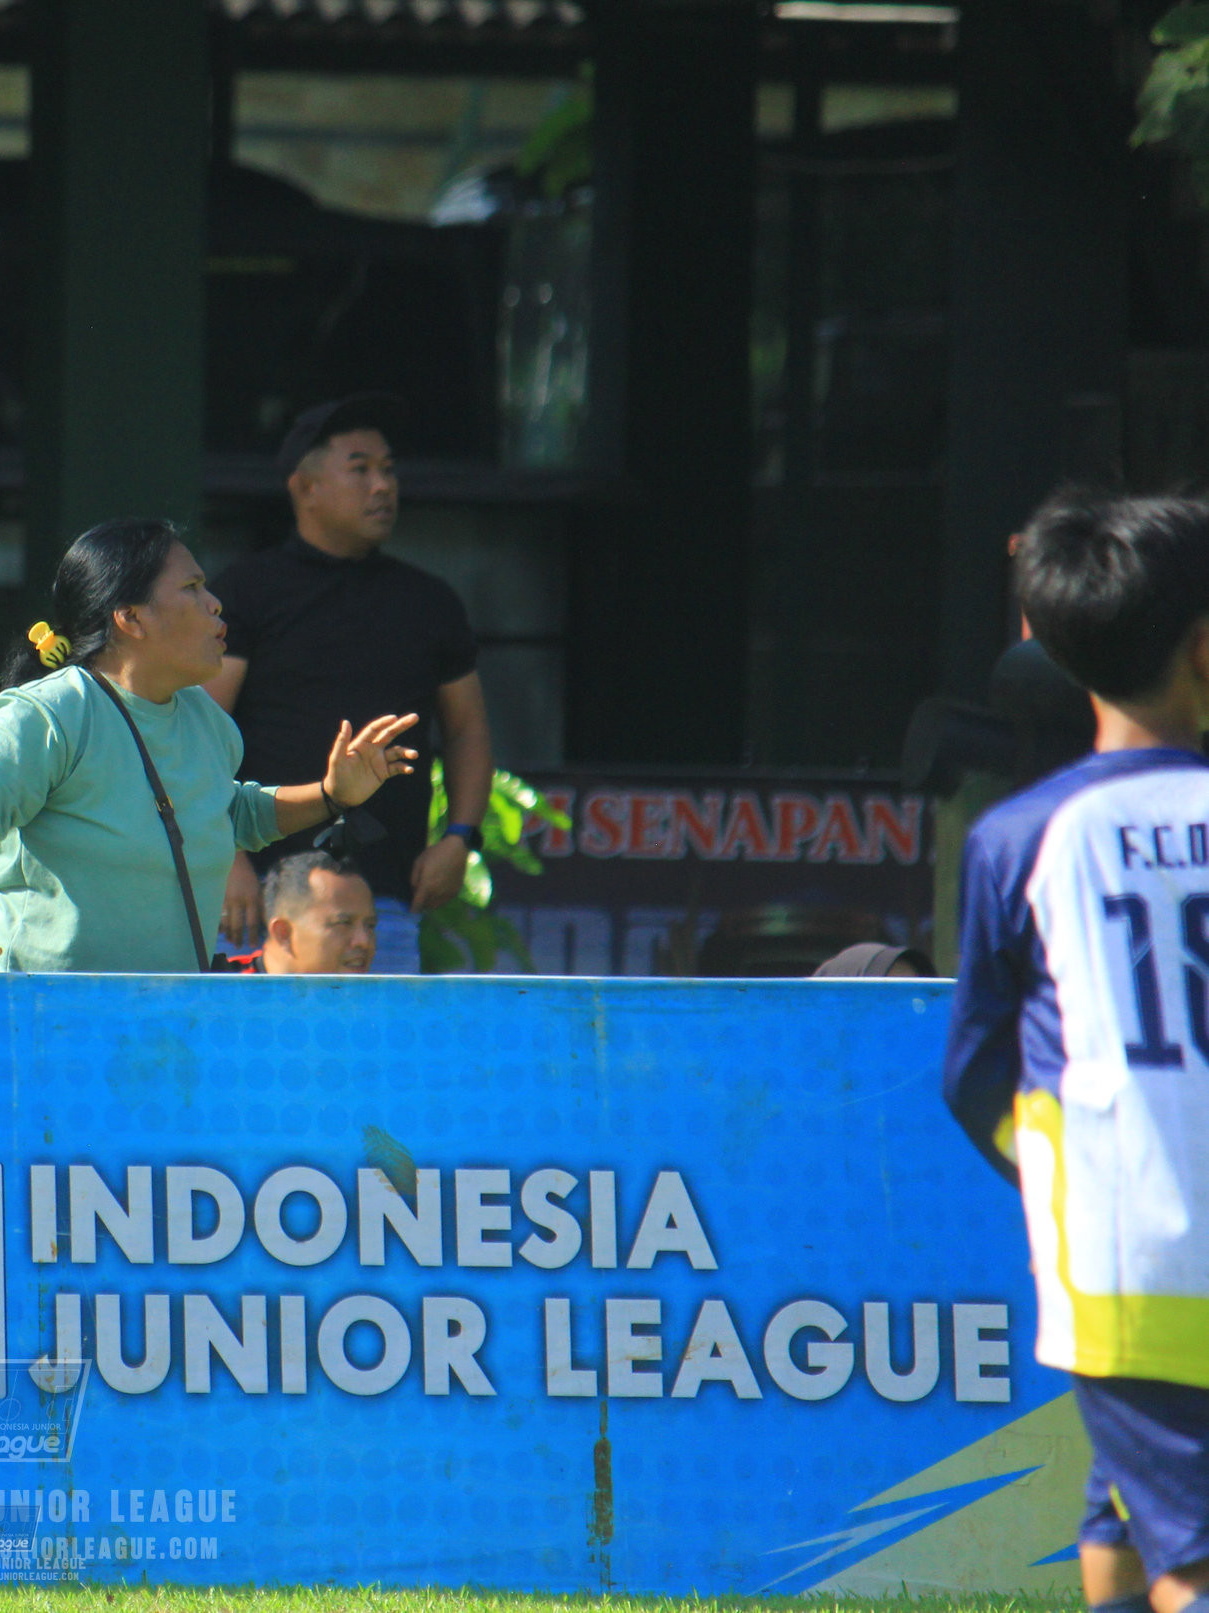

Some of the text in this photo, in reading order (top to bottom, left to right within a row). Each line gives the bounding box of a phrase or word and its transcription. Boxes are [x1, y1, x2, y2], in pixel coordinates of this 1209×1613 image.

[580, 788, 925, 864] SENAPAN
[30, 1165, 718, 1270] INDONESIA
[28, 1294, 1011, 1402] JUNIOR LEAGUE
